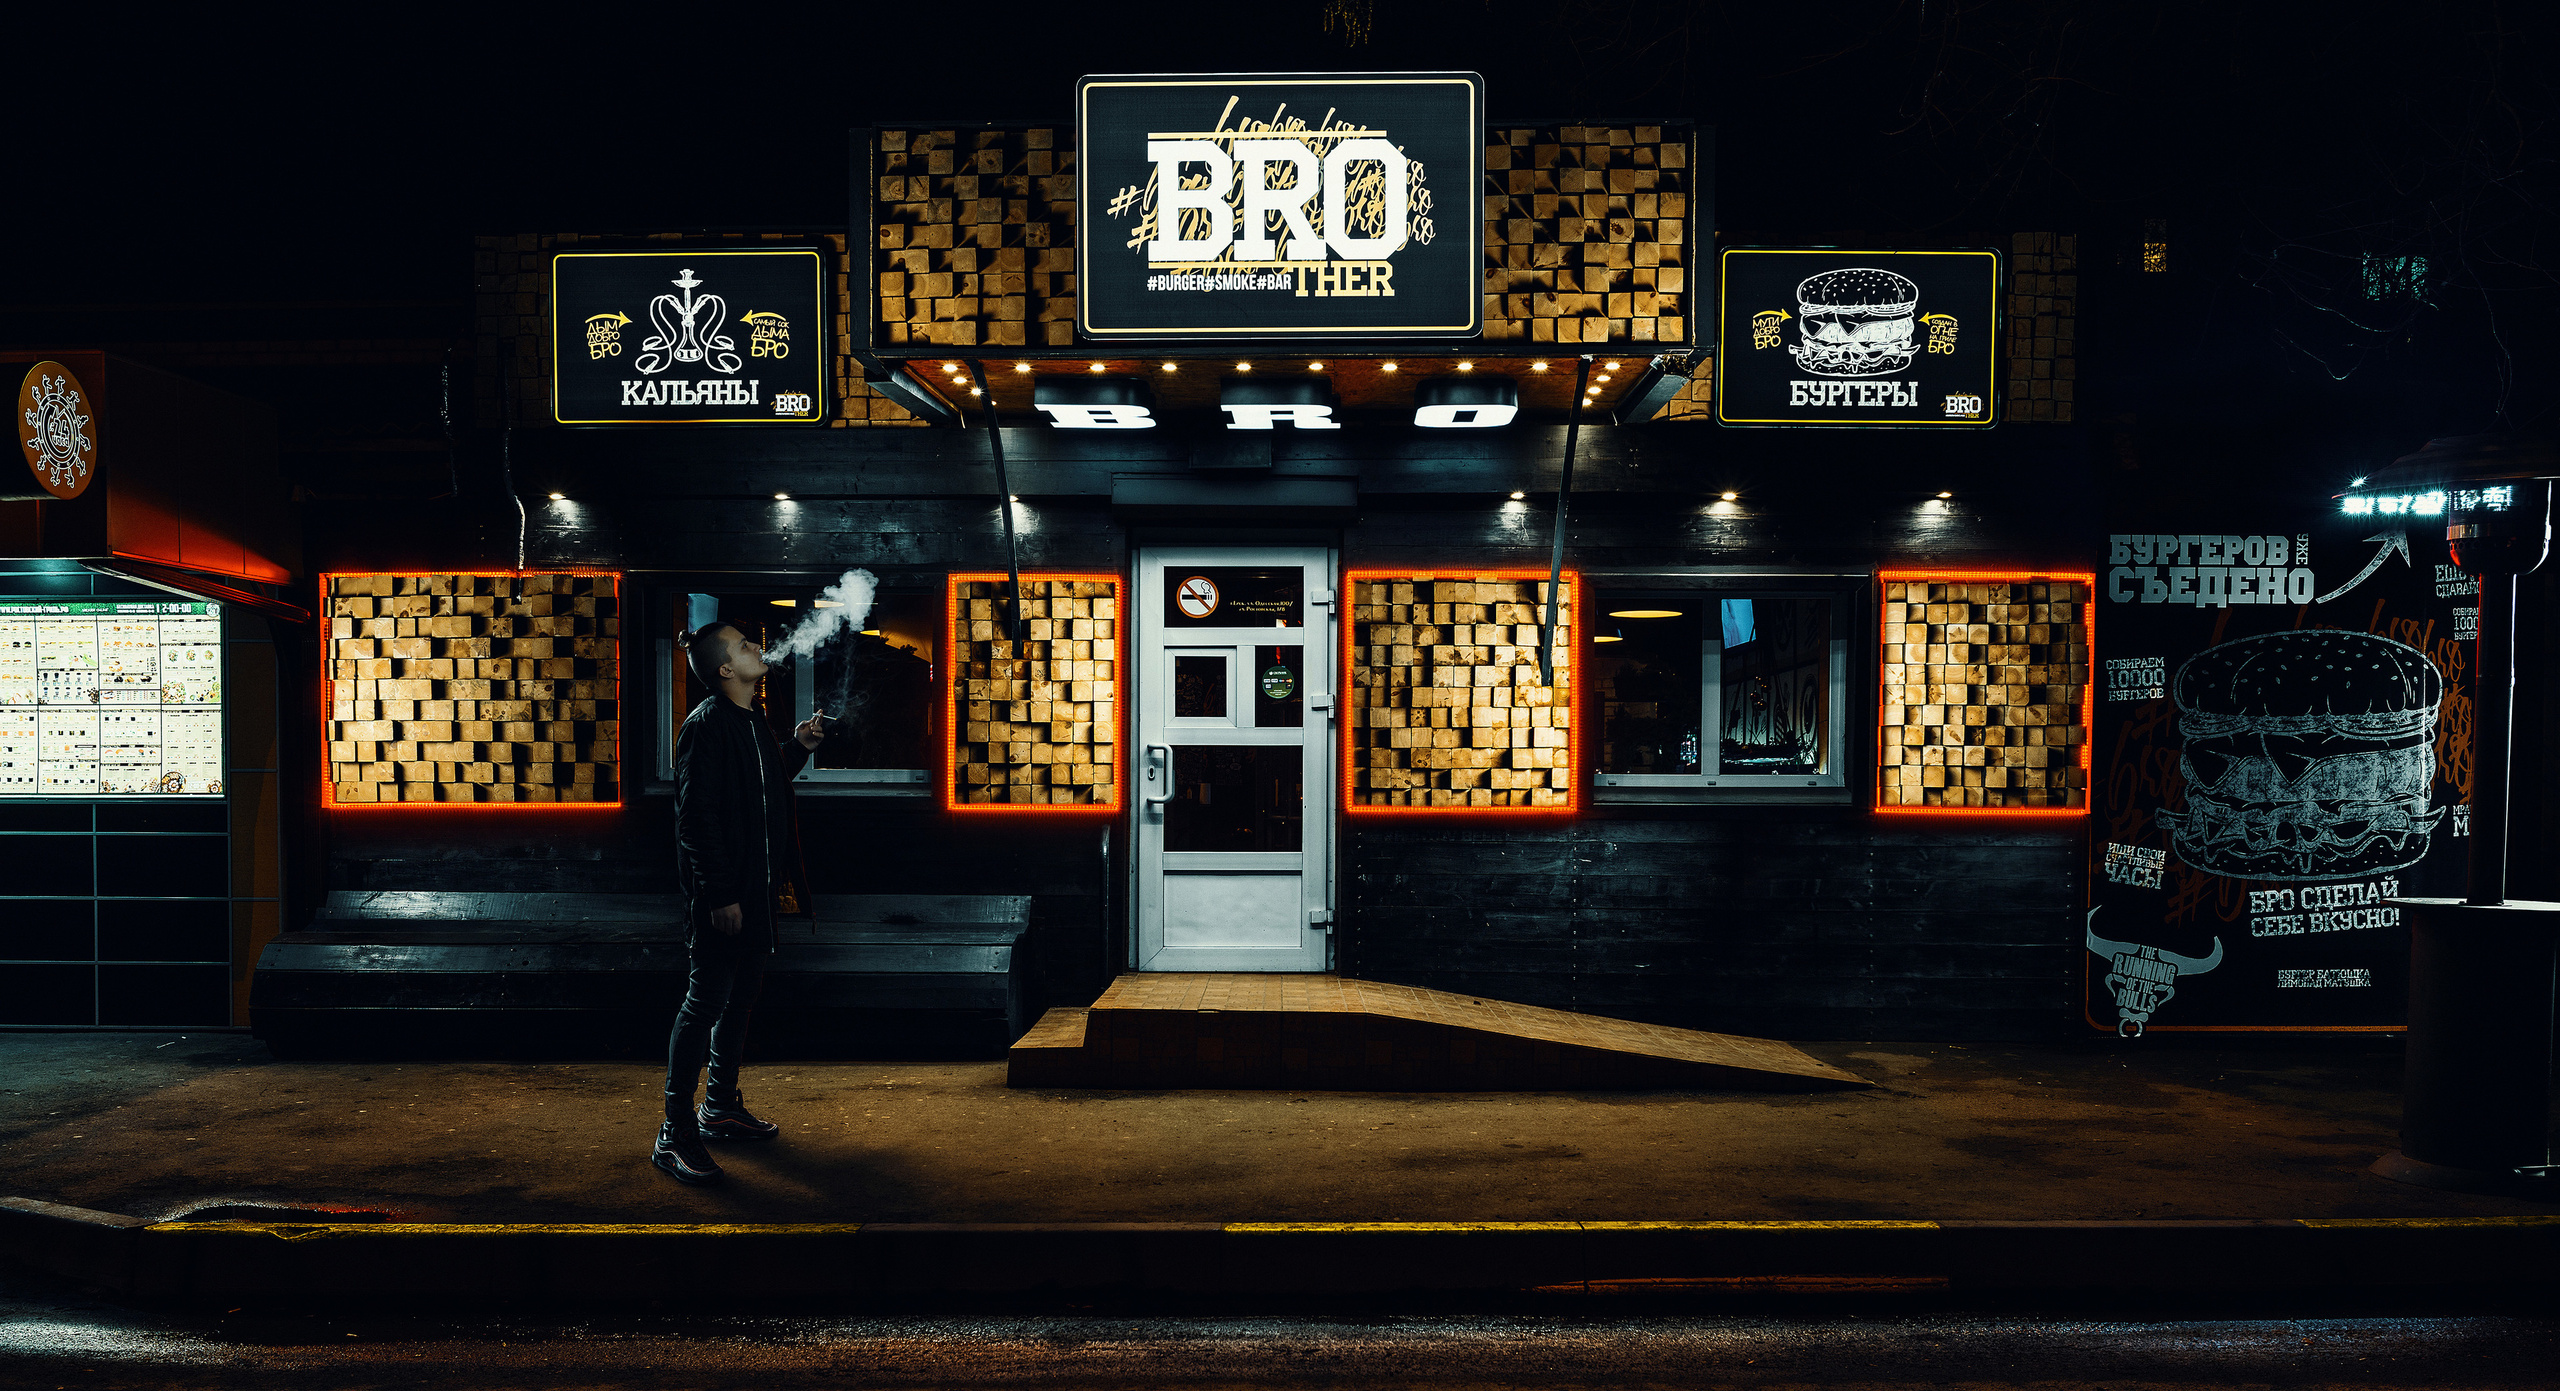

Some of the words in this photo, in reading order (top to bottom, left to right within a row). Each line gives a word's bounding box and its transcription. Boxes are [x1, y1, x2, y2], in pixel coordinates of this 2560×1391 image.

[1148, 139, 1407, 260] BRO
[1147, 274, 1292, 291] #BURGER#SMOKE#BAR
[1288, 260, 1395, 297] THER
[587, 320, 618, 339] ДЫМ
[1752, 316, 1780, 329] МУТИ
[1930, 325, 1960, 337] ОГНЕ
[588, 331, 620, 346] ДОБРО
[751, 325, 790, 341] ДЫМА
[1753, 326, 1781, 339] ДОБРО
[590, 342, 622, 360] БРО
[751, 338, 790, 359] БРО
[1755, 335, 1782, 350] БРО
[1928, 339, 1955, 355] БРО
[621, 380, 759, 405] КАЛЬЯНЫ
[1789, 380, 1919, 407] БУРГЕРЫ
[775, 394, 811, 412] BRO
[1945, 396, 1982, 414] BRO
[2109, 534, 2290, 566] БУРГЕРОВ
[2295, 532, 2309, 566] УЖЕ
[2108, 566, 2316, 608] СЪЕДЕНО
[2105, 656, 2166, 670] СОБИРАЕМ
[2108, 668, 2166, 689] 10000
[2108, 687, 2165, 702] БУРГЕРОВ
[2104, 861, 2165, 890] ЧАСЫ
[2249, 888, 2296, 914] БРО
[2300, 874, 2400, 912] СДЕЛАЙ
[2250, 914, 2305, 938] СЕБЕ
[2308, 906, 2400, 934] ВКУСНО!
[2140, 944, 2158, 961] THE
[2112, 953, 2177, 986] RUNNING
[2125, 976, 2139, 991] OF
[2138, 979, 2156, 995] THE
[2115, 987, 2158, 1014] BULLS
